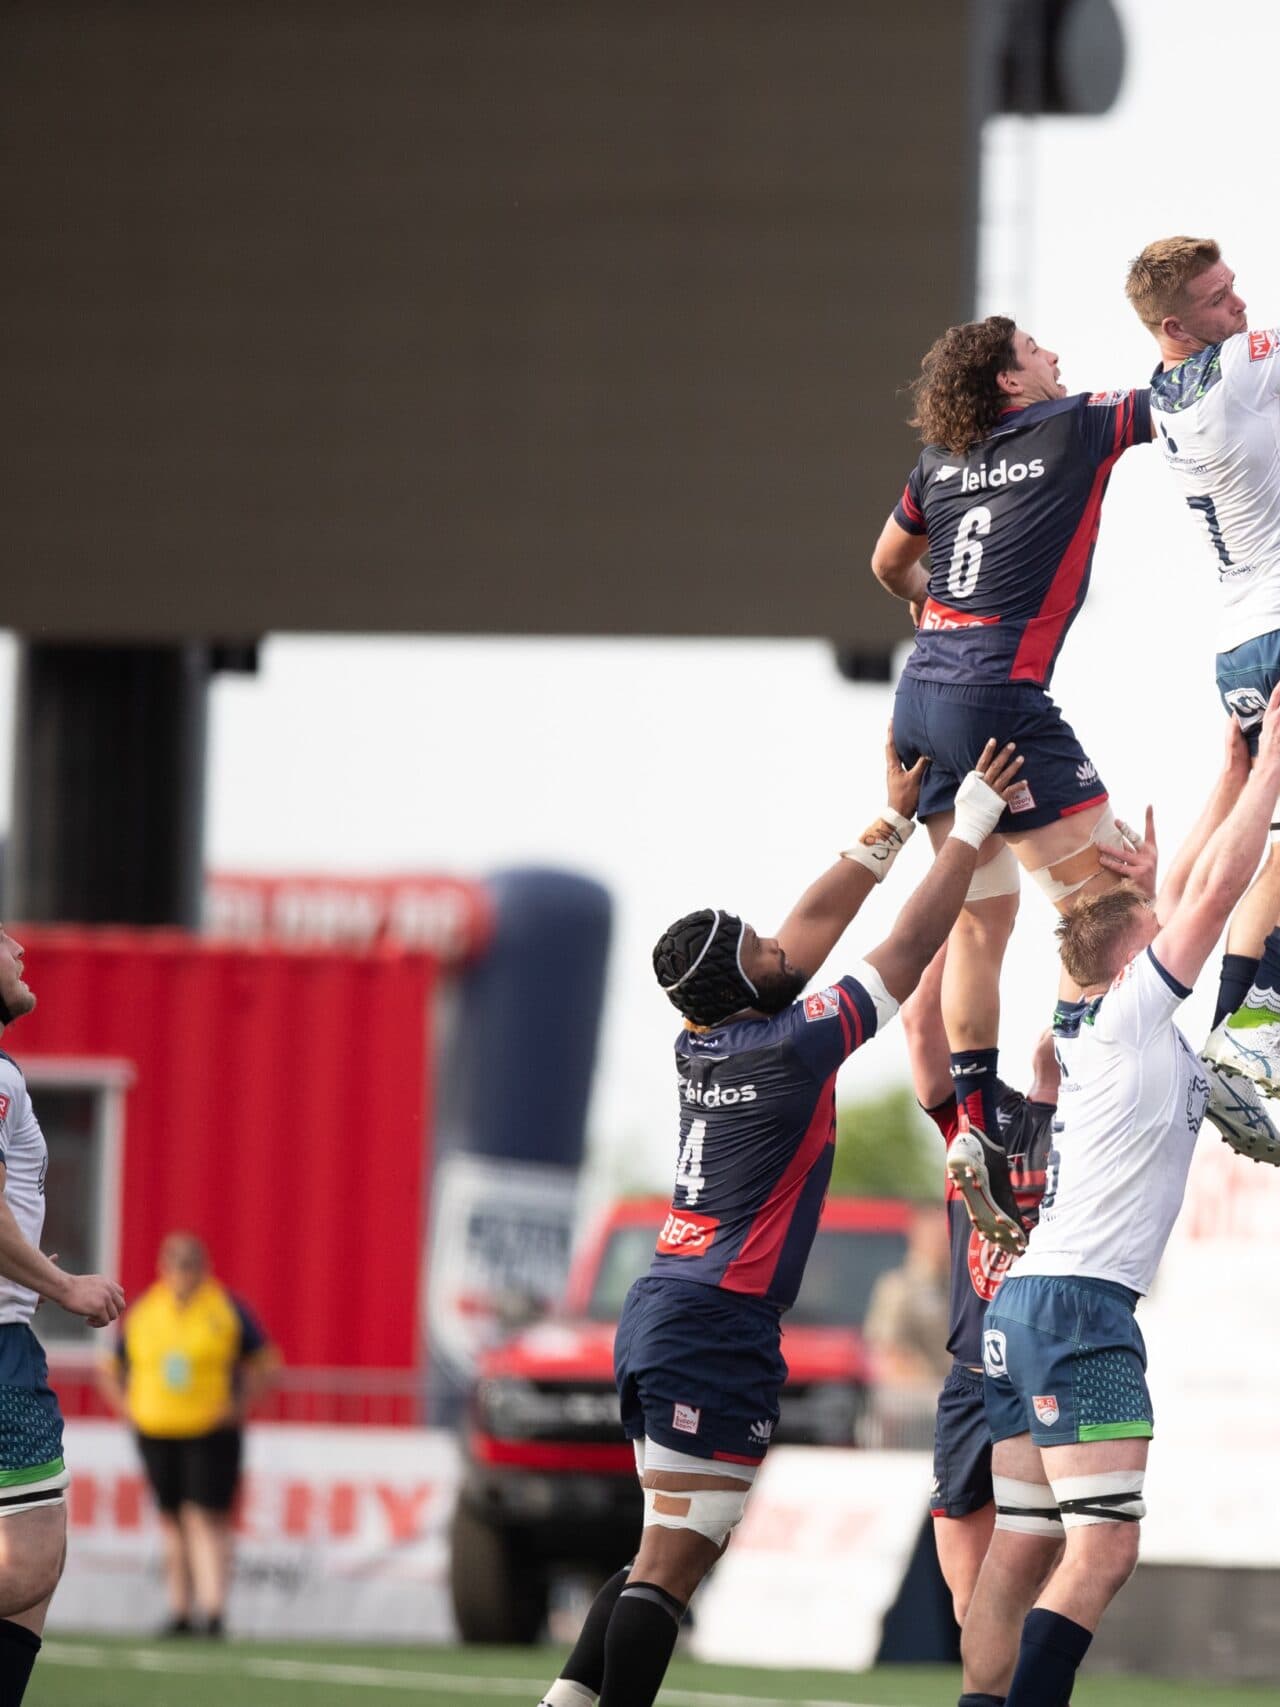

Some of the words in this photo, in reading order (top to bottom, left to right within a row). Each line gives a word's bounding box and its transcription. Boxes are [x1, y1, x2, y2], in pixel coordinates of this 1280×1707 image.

[961, 459, 1045, 493] leidos
[947, 506, 992, 598] 6
[675, 1118, 707, 1206] 4
